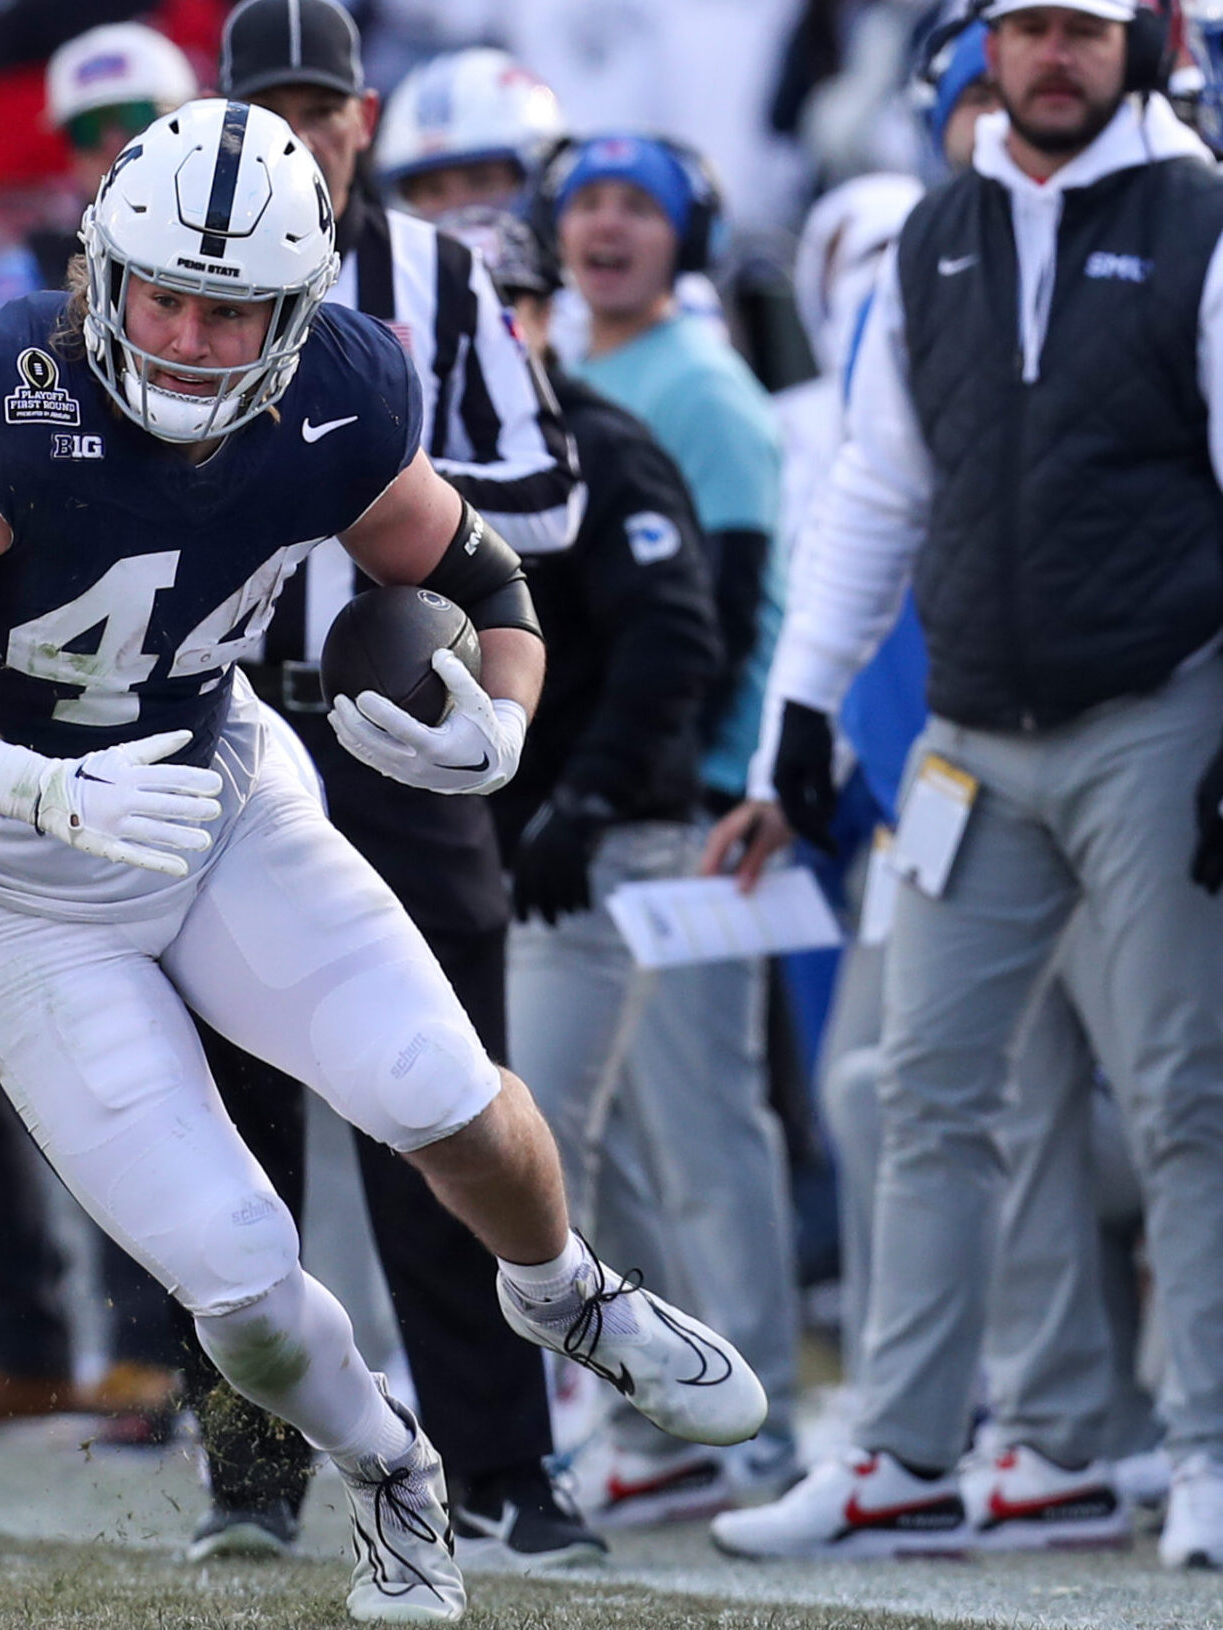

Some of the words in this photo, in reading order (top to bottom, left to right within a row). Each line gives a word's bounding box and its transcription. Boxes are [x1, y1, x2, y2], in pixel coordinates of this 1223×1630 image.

[177, 257, 206, 272] PENN
[208, 264, 240, 278] STATE
[21, 390, 65, 401] PLAYOFF
[10, 400, 41, 410] FIRST
[43, 401, 76, 412] ROUND
[6, 540, 318, 727] 44
